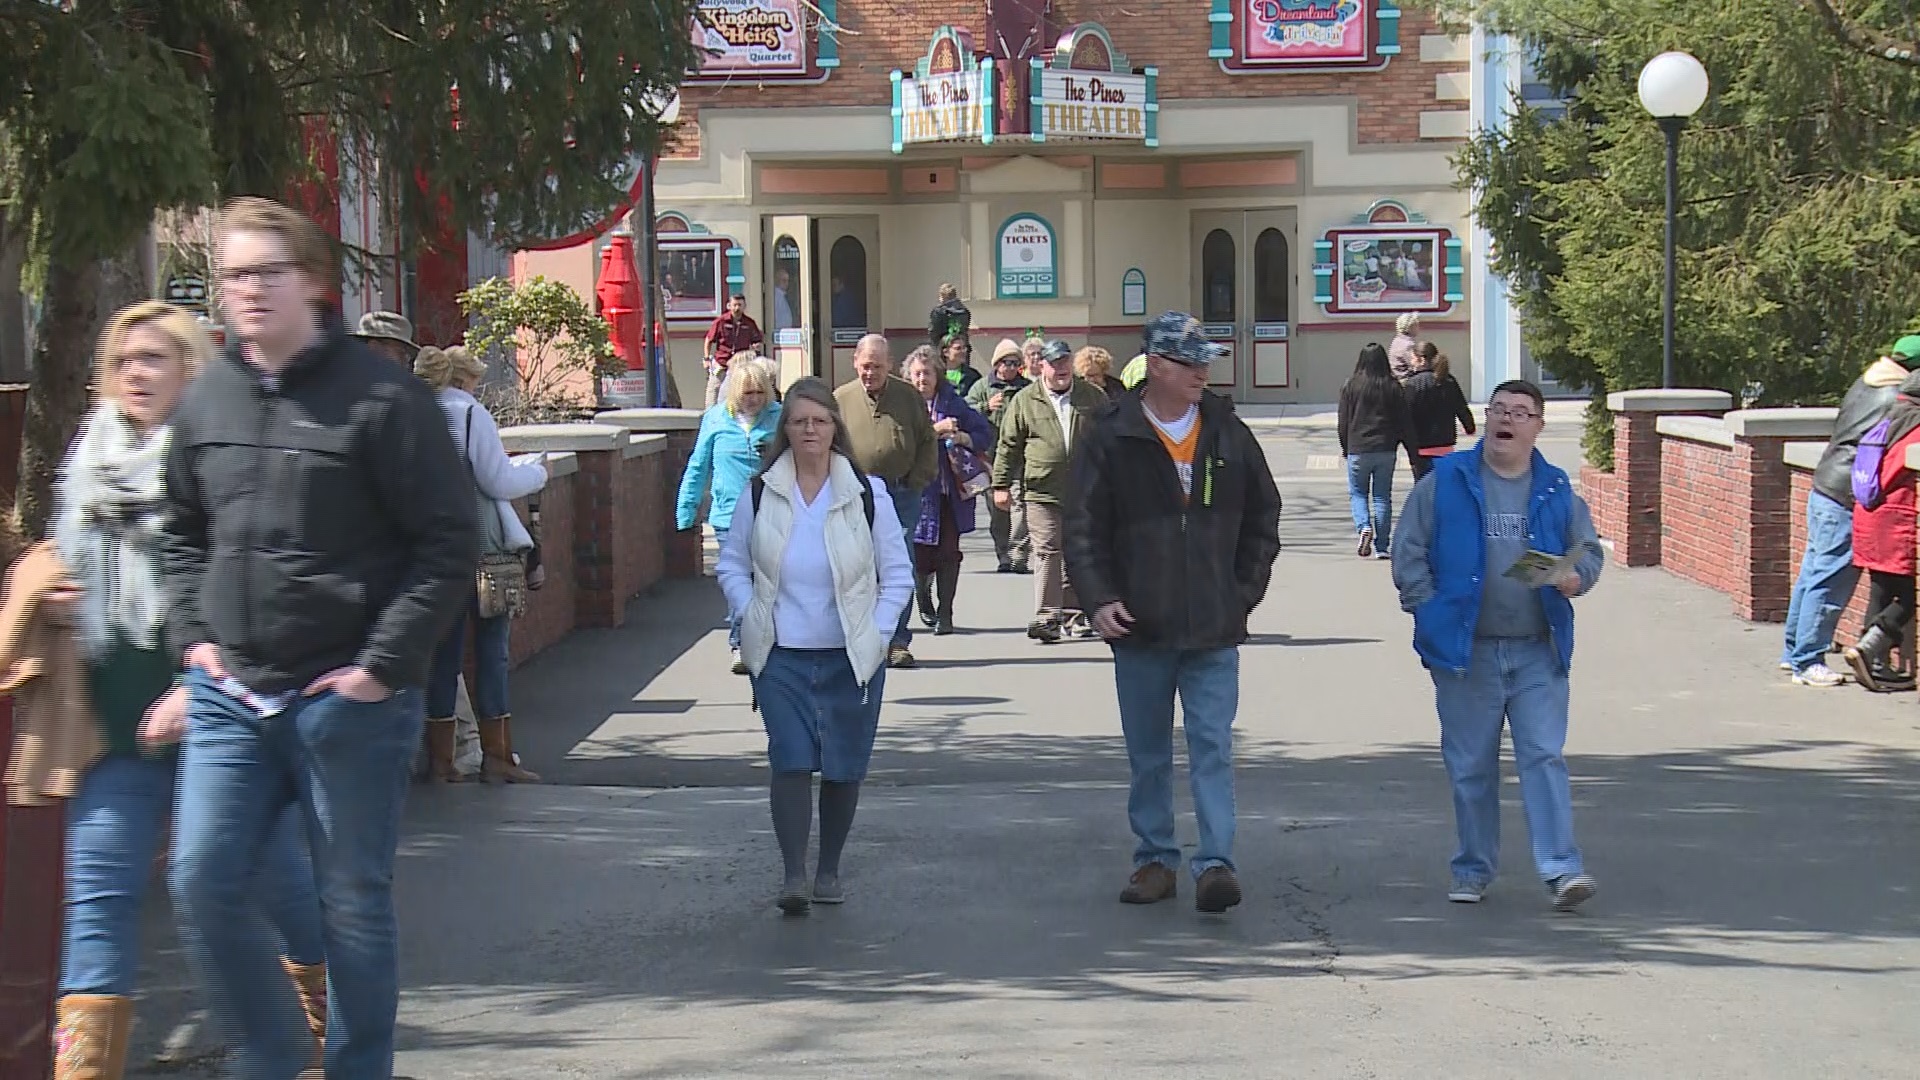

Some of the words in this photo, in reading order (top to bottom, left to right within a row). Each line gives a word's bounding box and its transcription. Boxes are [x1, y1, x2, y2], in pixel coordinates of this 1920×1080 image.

[699, 8, 792, 31] Kingdom
[1255, 0, 1337, 20] Dreamland
[722, 27, 779, 49] Heirs
[750, 53, 792, 61] Quartet
[918, 82, 938, 107] The
[941, 79, 970, 104] Pines
[1061, 76, 1086, 101] The
[1088, 77, 1126, 104] Pines
[907, 102, 983, 137] THEATER
[1044, 102, 1141, 134] THEATER
[1005, 235, 1049, 244] TICKETS
